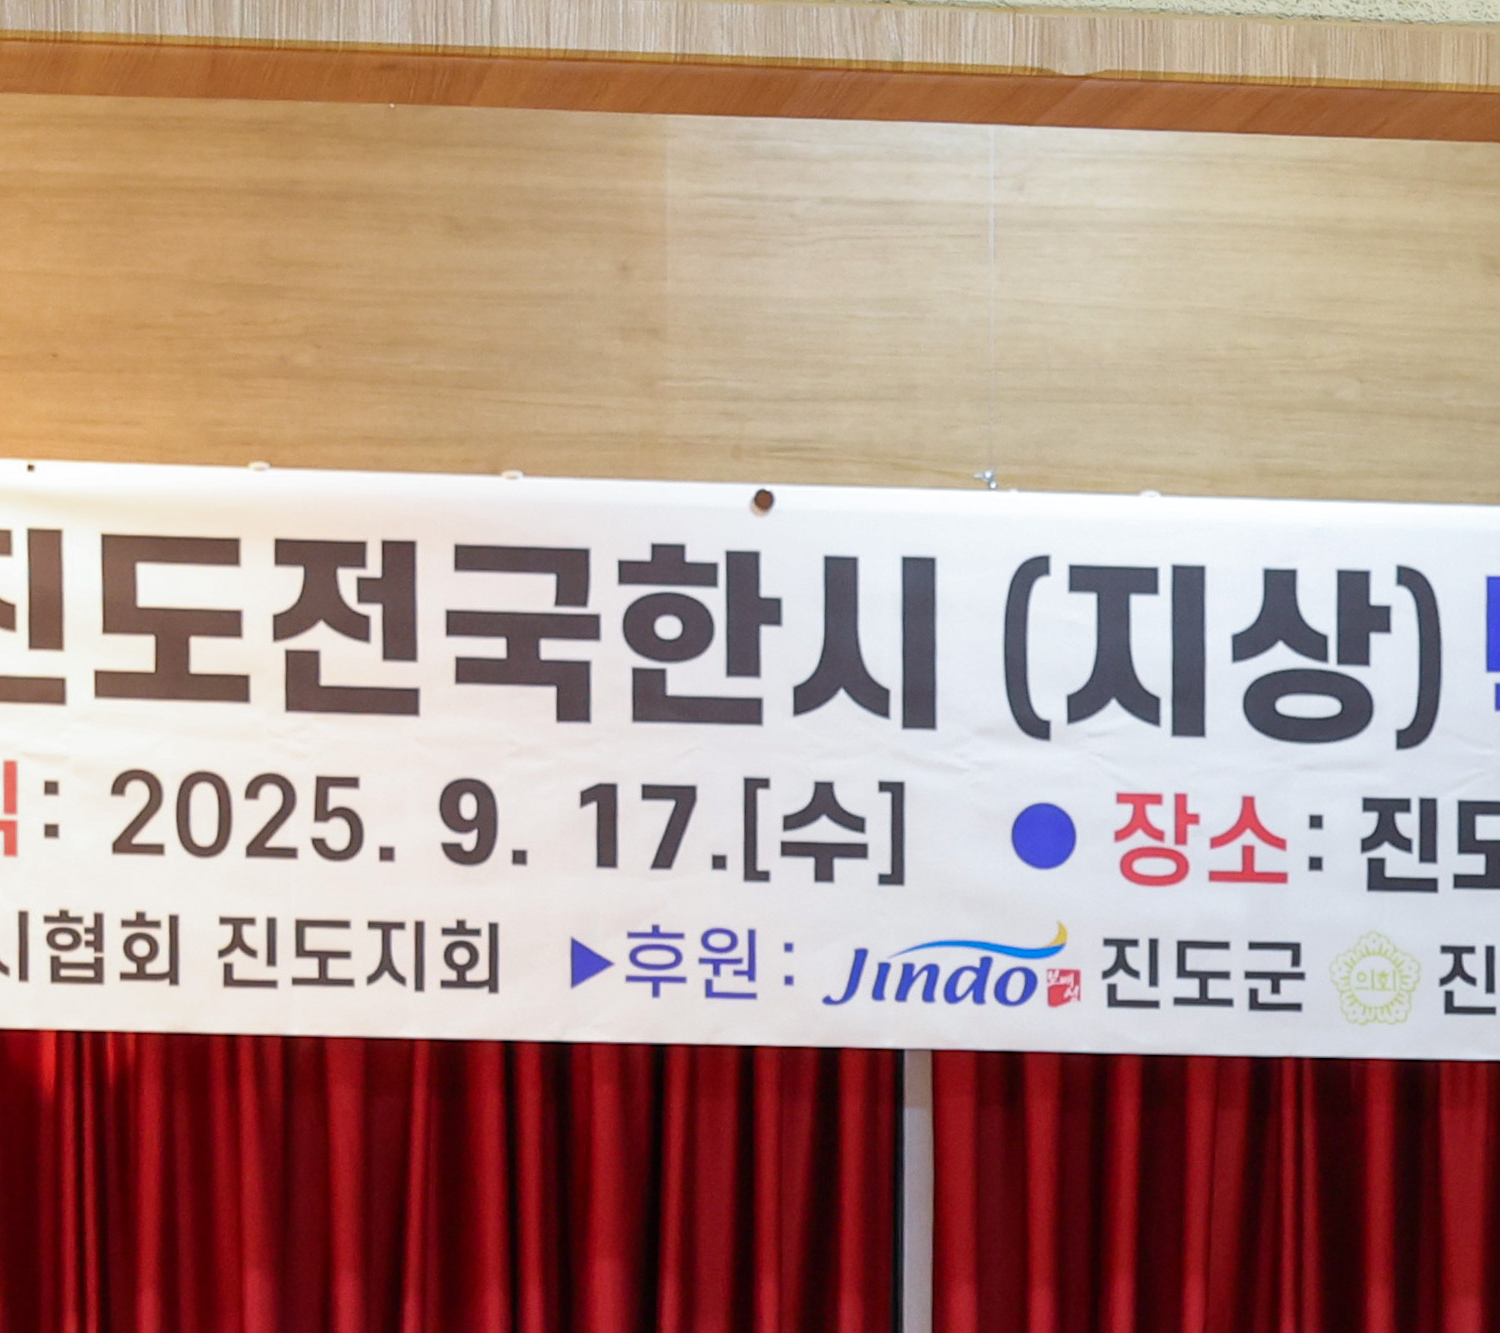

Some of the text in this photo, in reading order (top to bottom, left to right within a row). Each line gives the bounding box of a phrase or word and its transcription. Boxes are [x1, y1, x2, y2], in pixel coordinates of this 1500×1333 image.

[1002, 554, 1443, 751] (지상)
[110, 768, 396, 863] 2025.
[438, 777, 528, 867] 9.
[579, 776, 906, 887] 17.[수]
[217, 916, 500, 995] 진도지회
[822, 947, 1039, 1007] Jindo
[1101, 937, 1306, 1013] 진도군
